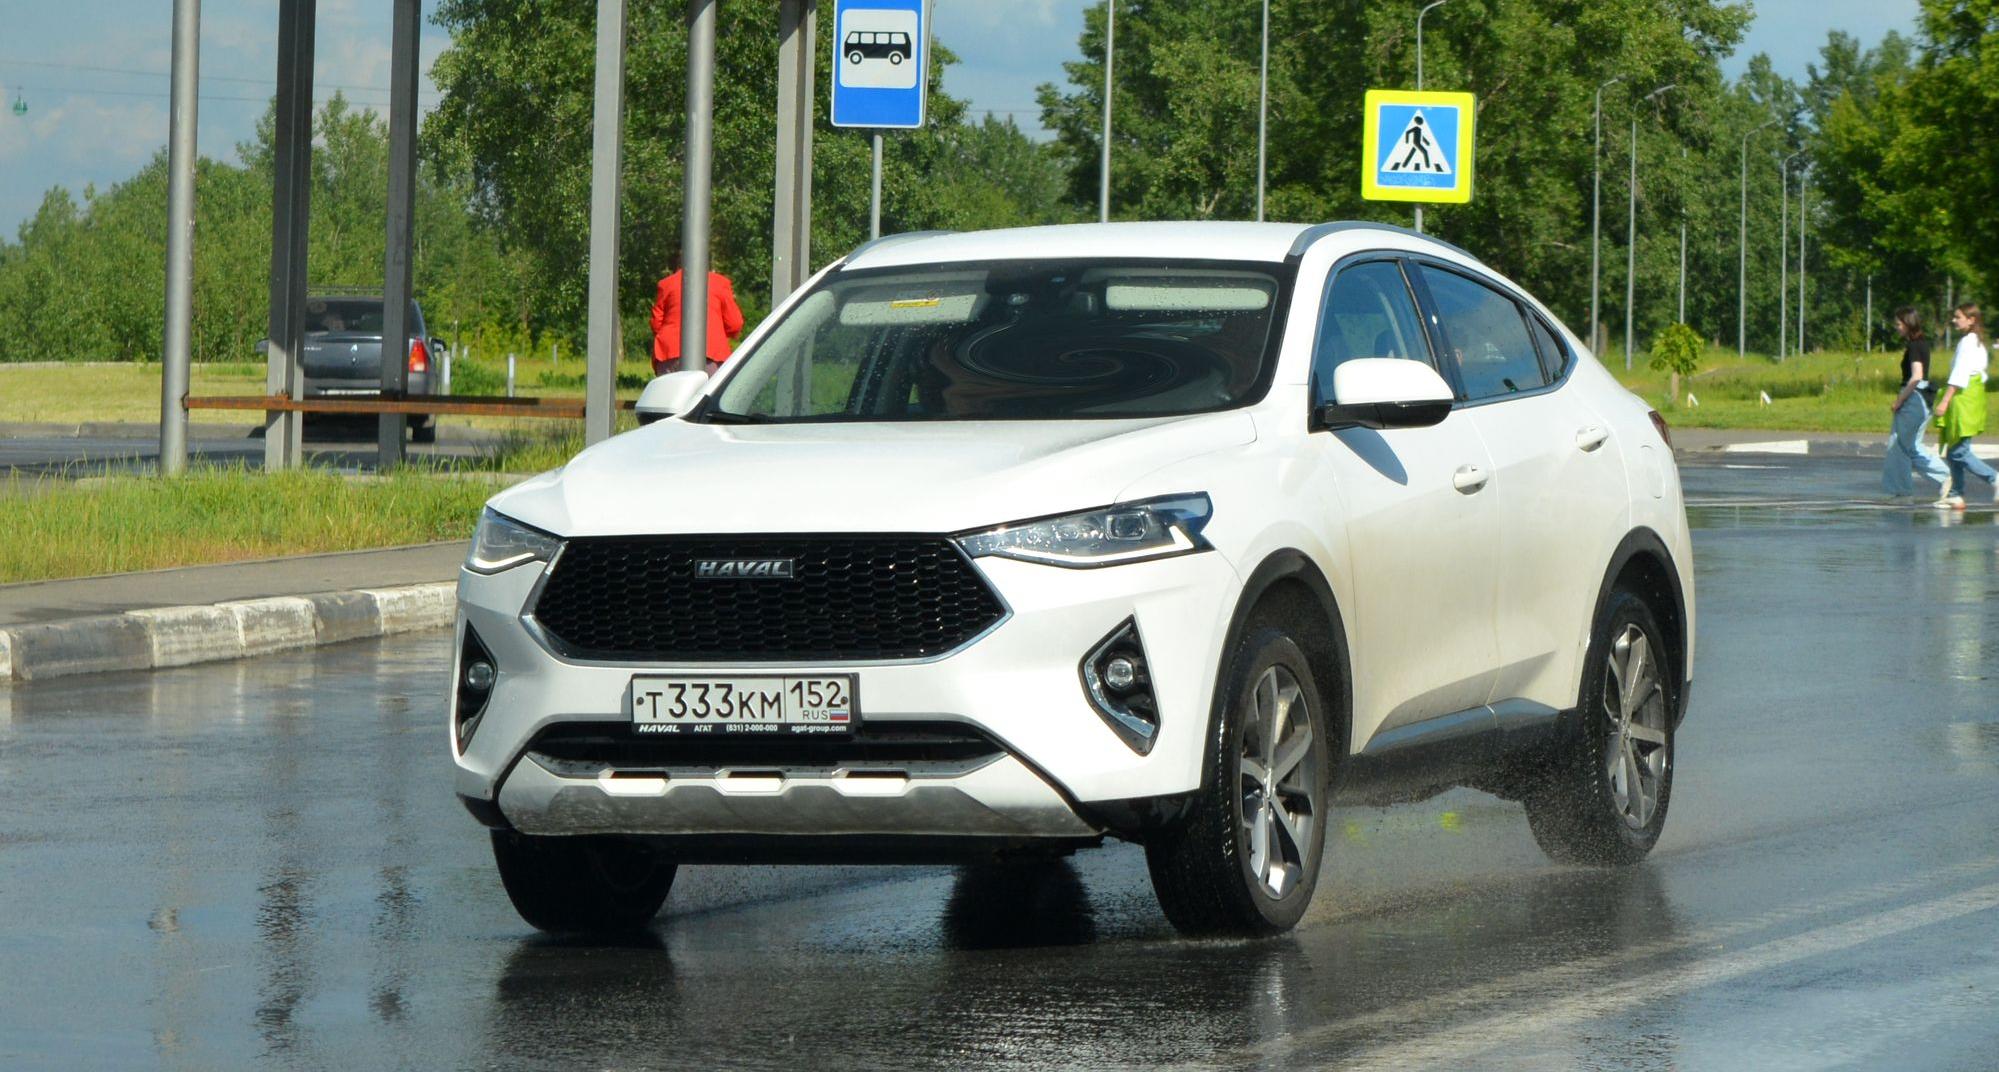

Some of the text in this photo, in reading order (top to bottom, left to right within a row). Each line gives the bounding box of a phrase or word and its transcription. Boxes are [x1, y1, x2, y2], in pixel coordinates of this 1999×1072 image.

[699, 561, 788, 576] HAVAL
[790, 681, 842, 708] 152
[802, 709, 829, 720] RUS
[638, 724, 680, 733] HAVAL
[726, 723, 744, 733] (831)
[791, 724, 847, 733] agat-group.com
